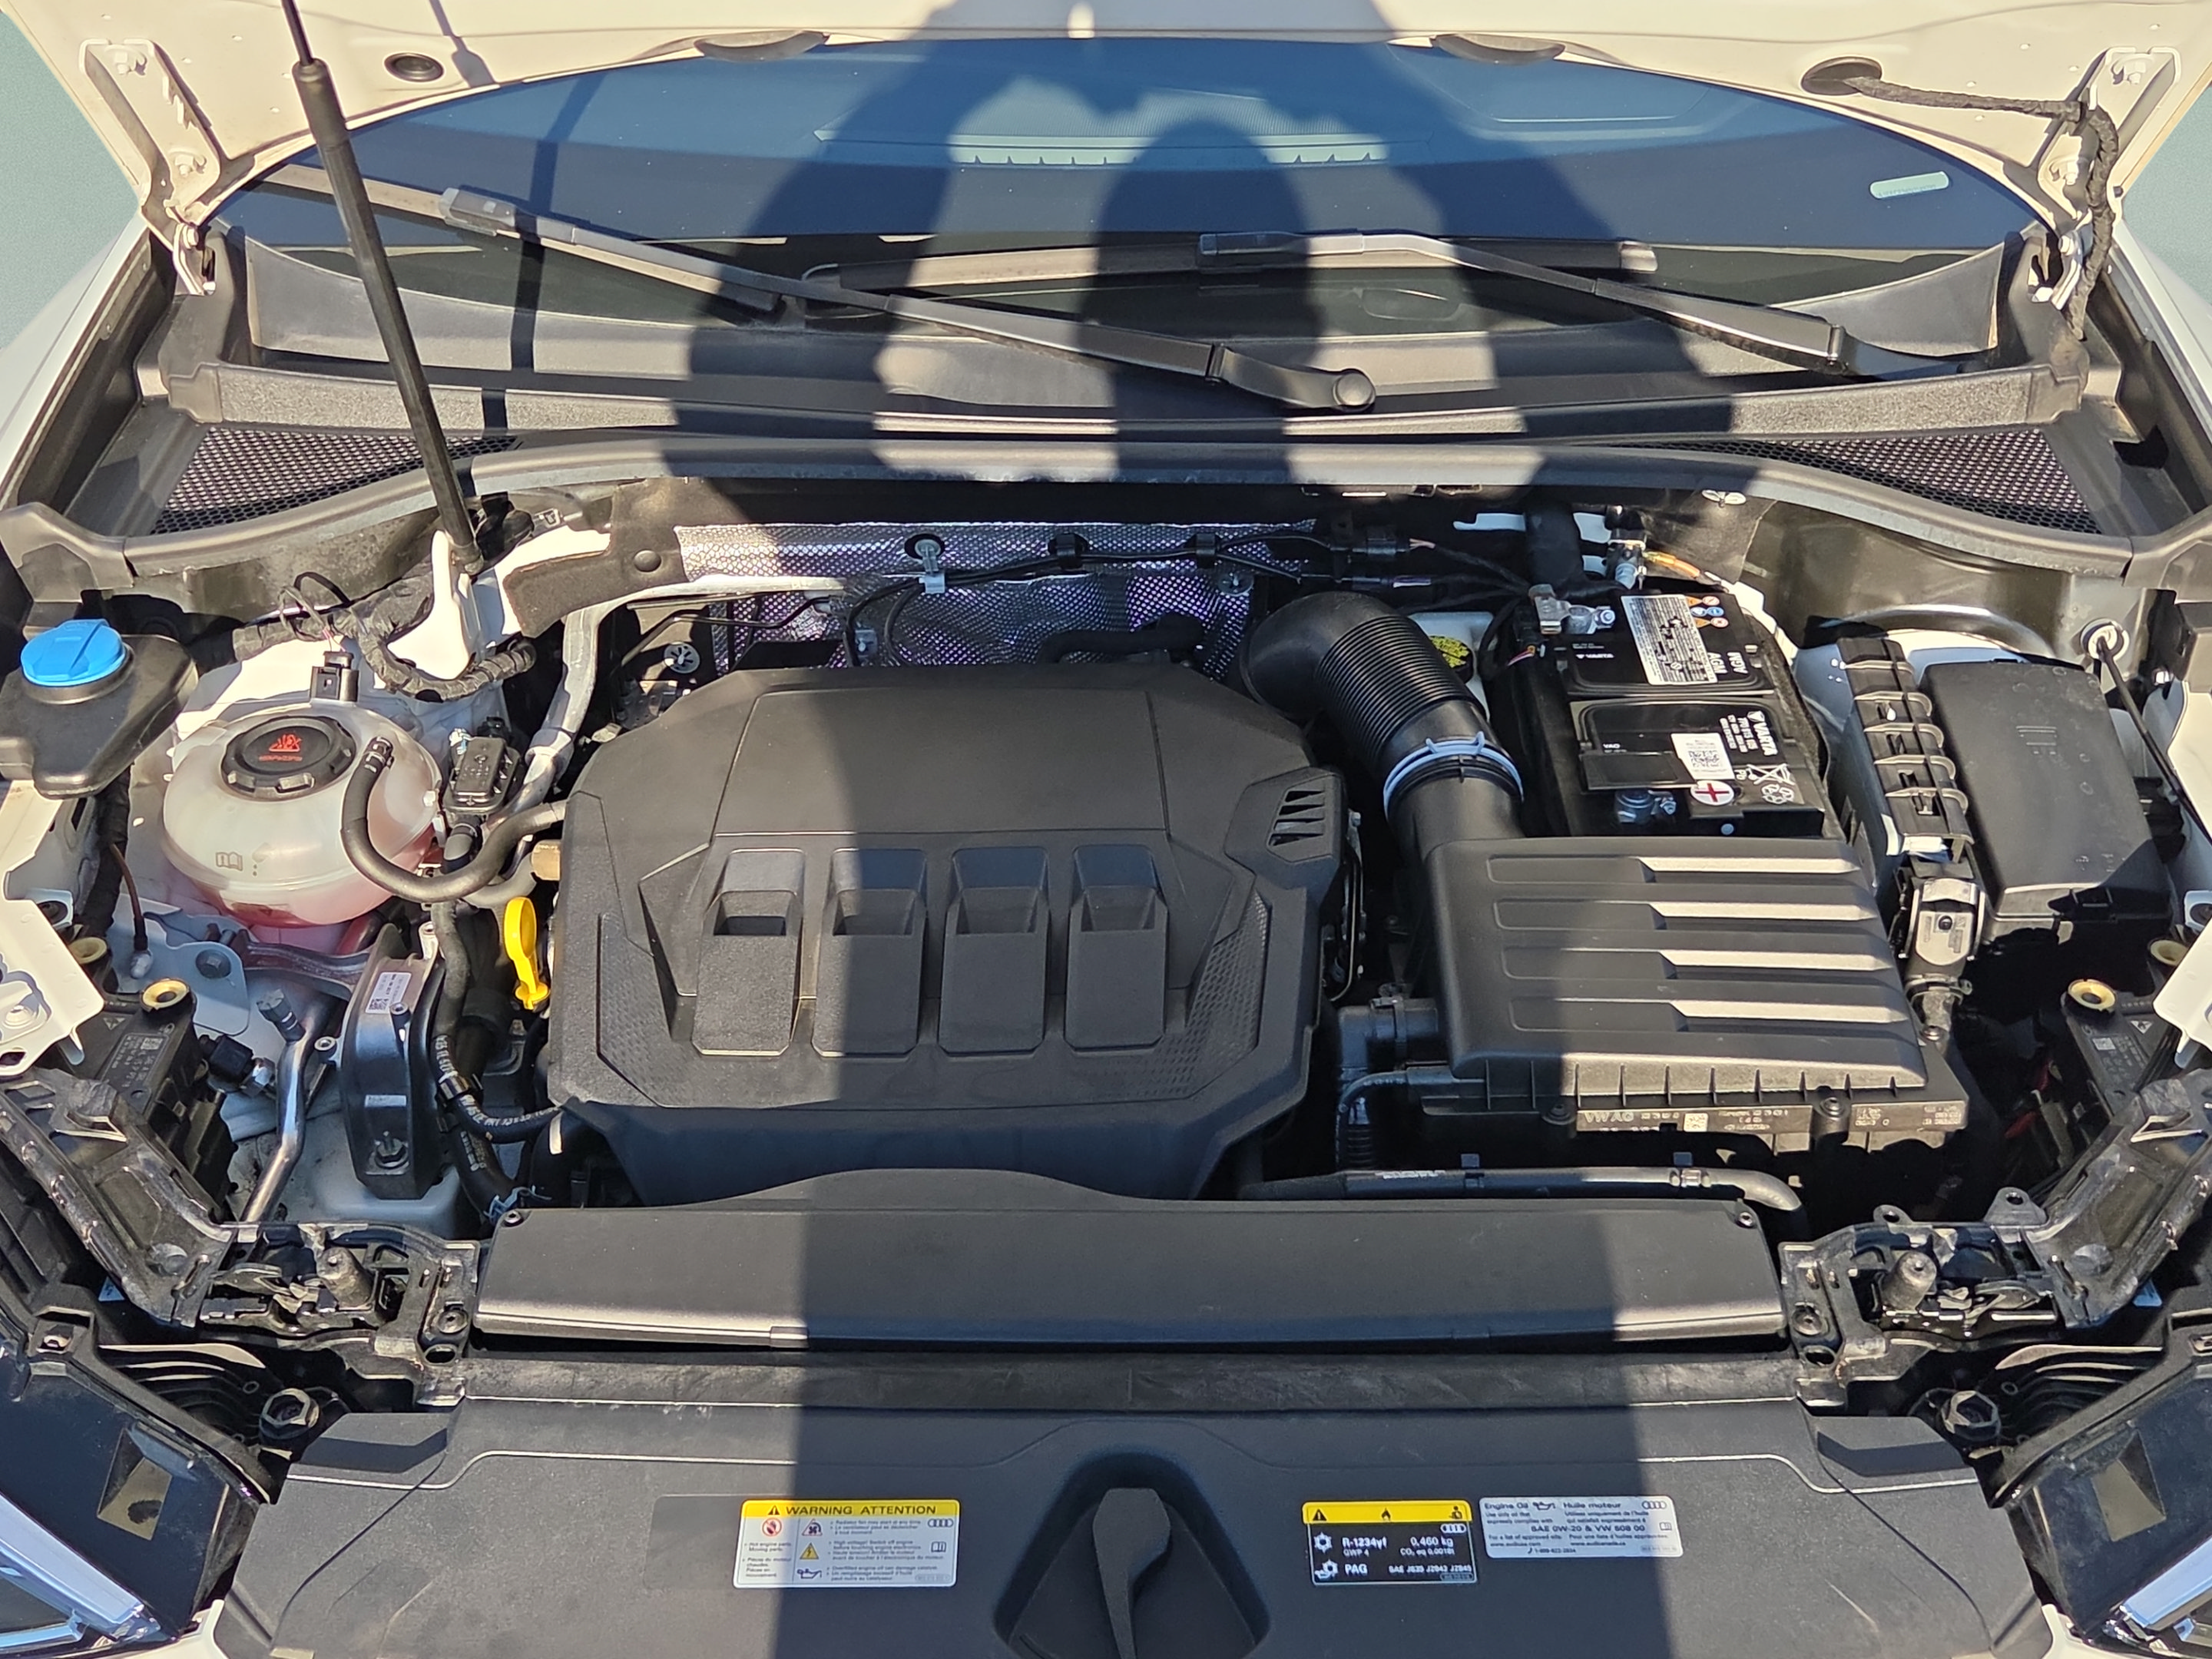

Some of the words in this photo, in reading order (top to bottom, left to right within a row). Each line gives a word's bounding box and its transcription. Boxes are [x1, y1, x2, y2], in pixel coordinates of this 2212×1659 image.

[1707, 651, 1728, 674] AGM
[1727, 651, 1748, 674] AGM
[1753, 722, 1779, 756] VARTA
[785, 1505, 853, 1515] WARNING
[860, 1505, 936, 1515] ATTENTION
[1342, 1537, 1387, 1550] R-1234yf
[1441, 1536, 1454, 1548] kg
[1343, 1549, 1363, 1558] GWP
[1344, 1564, 1368, 1575] PAG
